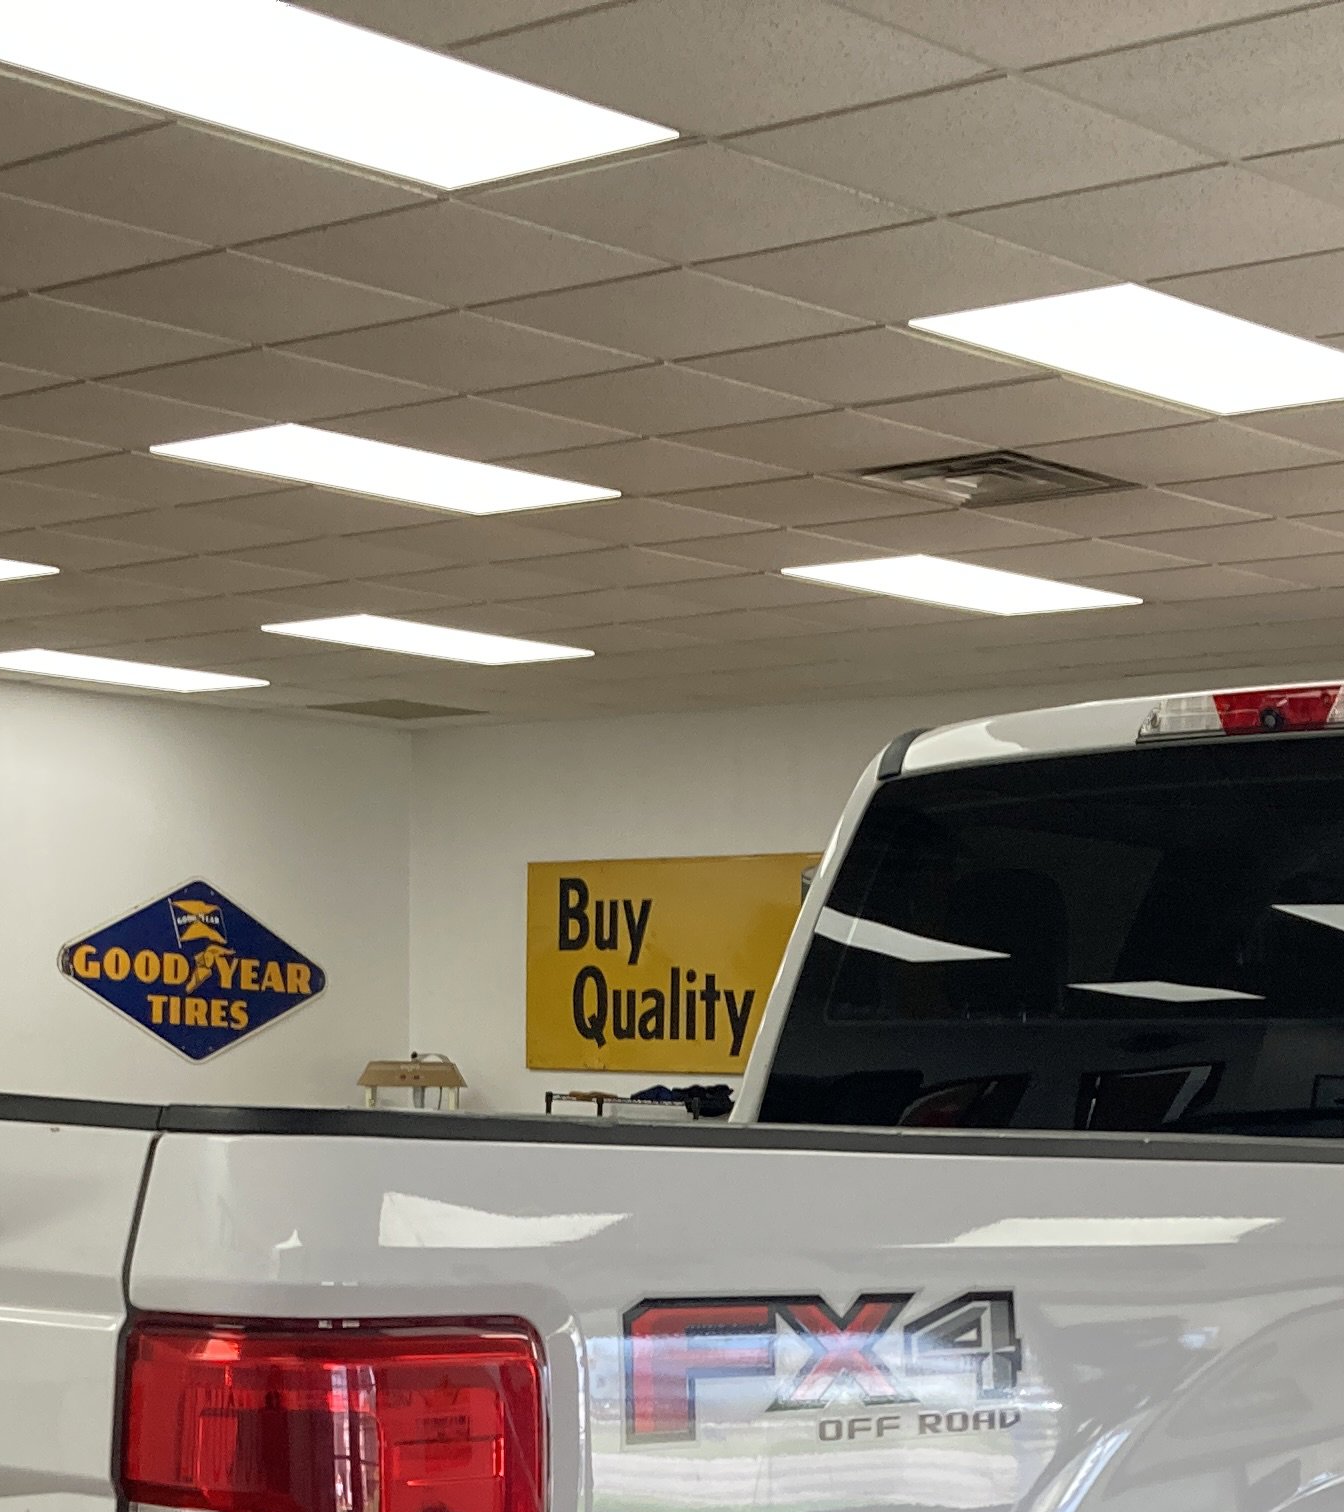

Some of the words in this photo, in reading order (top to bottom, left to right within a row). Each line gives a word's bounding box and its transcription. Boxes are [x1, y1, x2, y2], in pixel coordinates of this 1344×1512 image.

[558, 876, 653, 966] Buy
[146, 994, 249, 1031] TIRES
[572, 965, 756, 1057] Quality
[623, 1290, 1022, 1446] FX4
[818, 1415, 901, 1442] OFF
[918, 1408, 1021, 1435] ROAD
